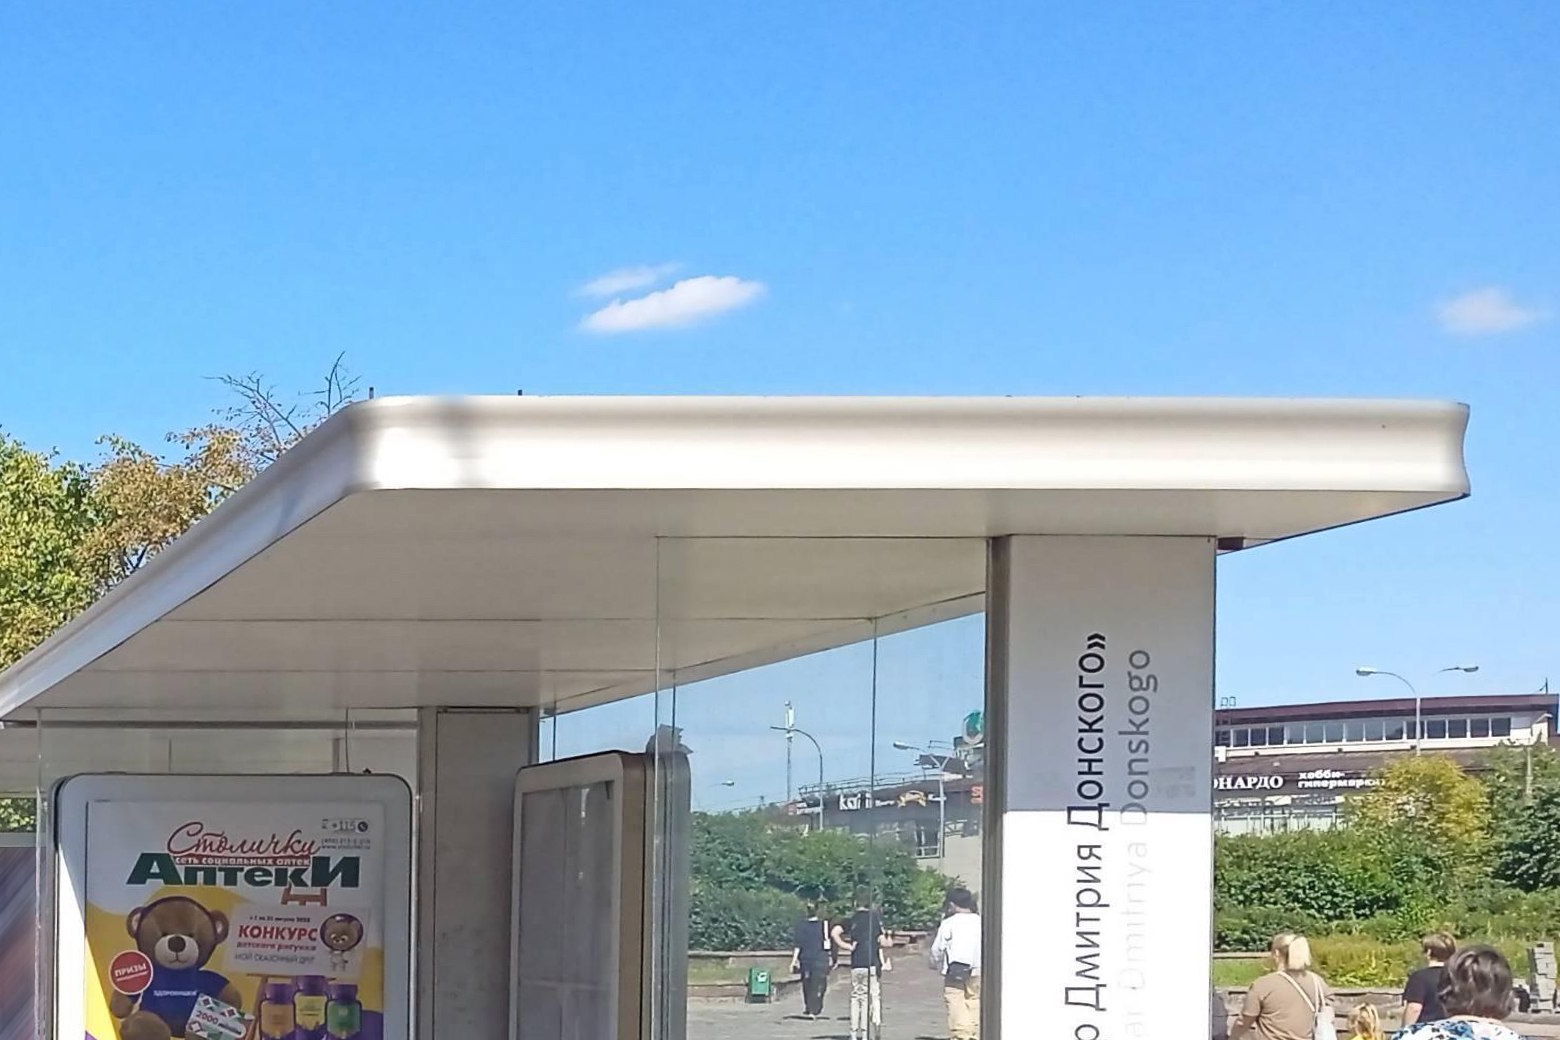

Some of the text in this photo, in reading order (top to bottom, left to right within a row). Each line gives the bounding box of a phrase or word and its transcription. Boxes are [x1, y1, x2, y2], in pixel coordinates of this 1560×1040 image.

[1066, 632, 1110, 832] Донского»
[1117, 649, 1159, 826] Donskogo
[166, 821, 322, 855] Столички
[175, 857, 310, 867] сеть социальных аптек
[238, 924, 318, 942] КОНКУРС
[1064, 843, 1110, 1012] Дмитрия
[114, 963, 147, 977] ПРИЗЫ
[195, 1010, 219, 1025] 2000
